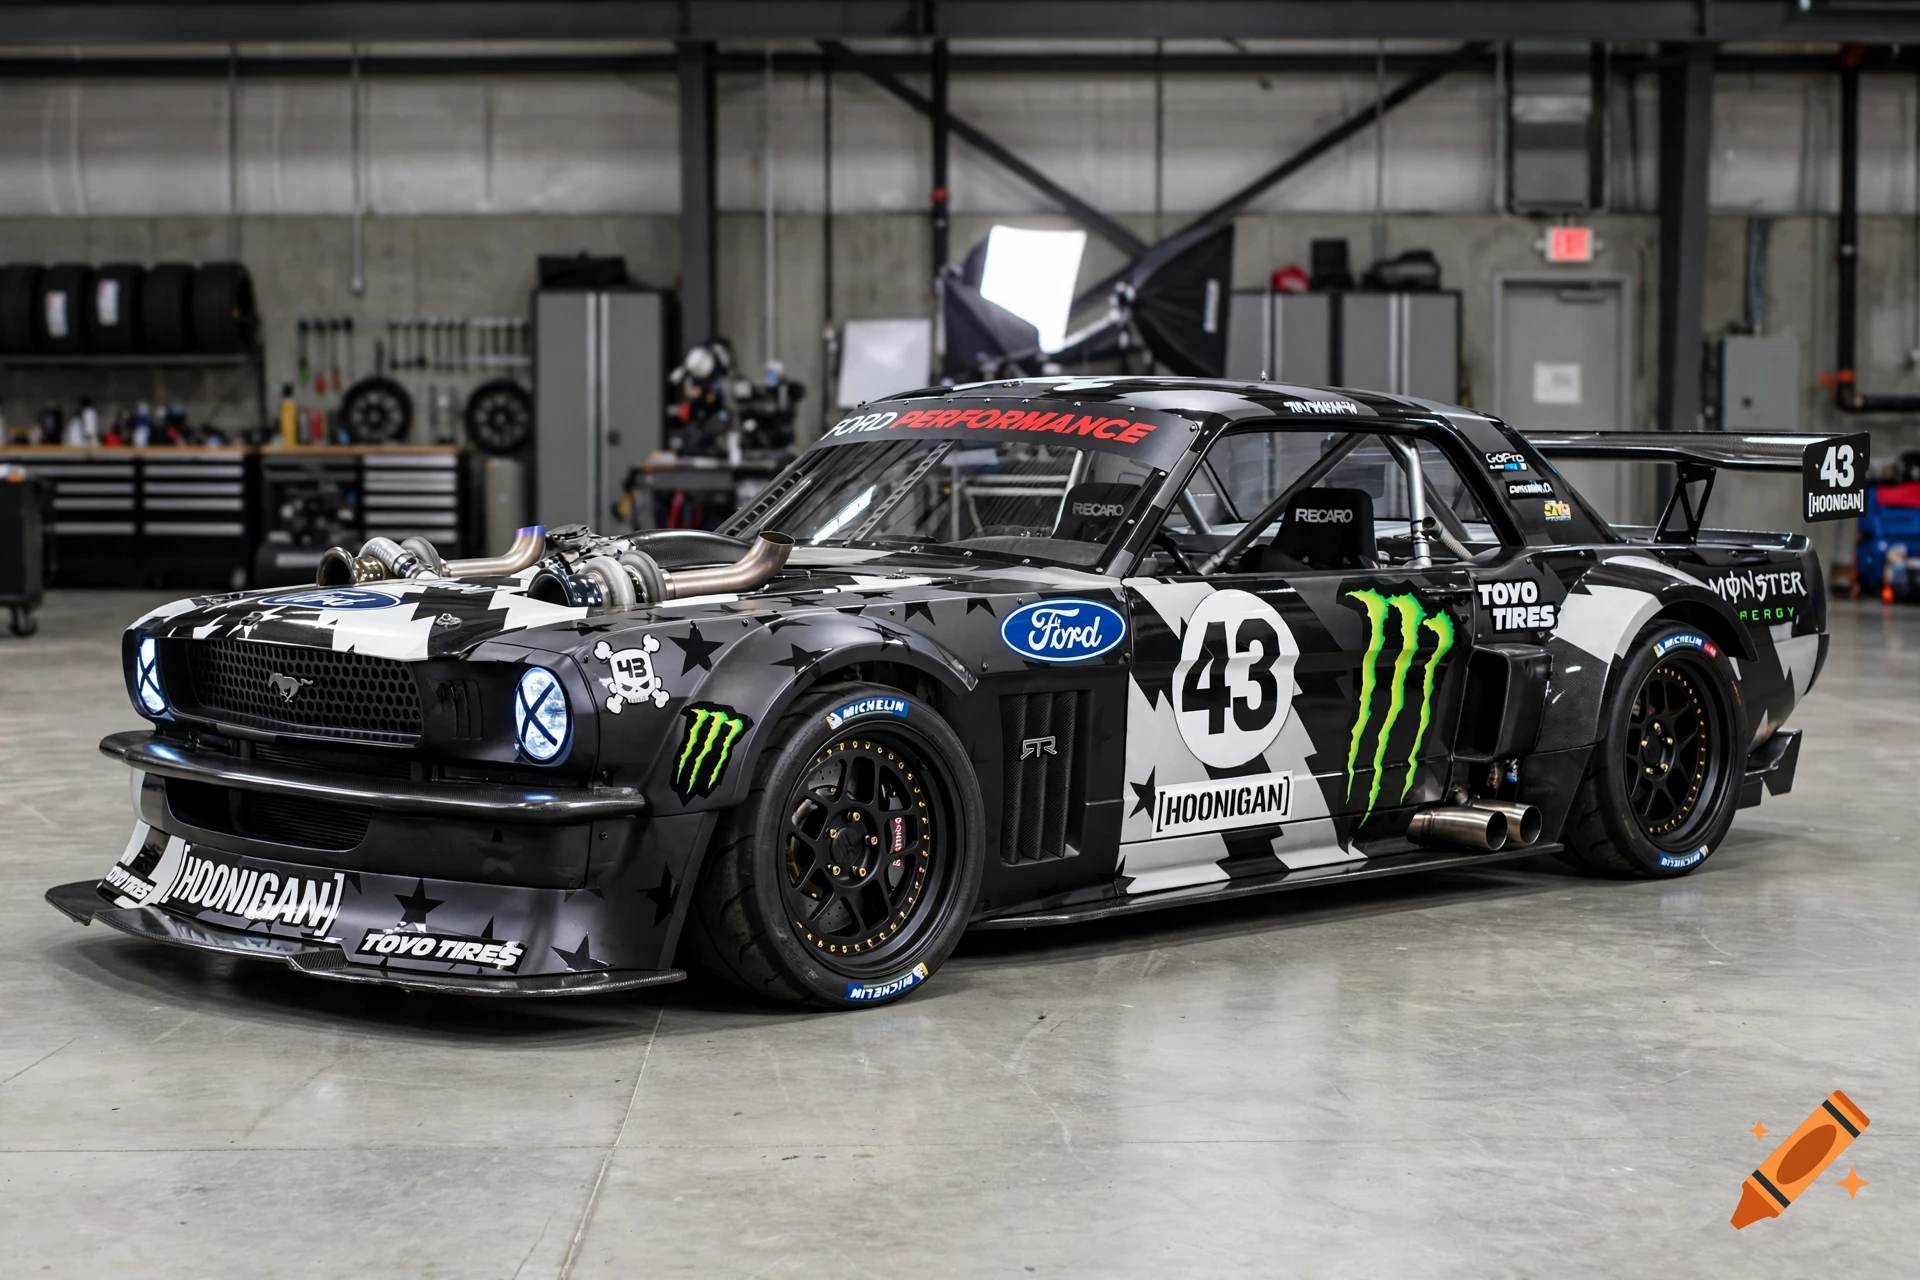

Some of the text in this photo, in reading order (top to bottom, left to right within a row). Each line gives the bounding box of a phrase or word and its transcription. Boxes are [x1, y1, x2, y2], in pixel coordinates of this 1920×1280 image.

[819, 408, 1157, 444] FORD PERFORMANCE
[1820, 444, 1855, 487] 43
[1072, 501, 1124, 517] RECARO
[1295, 508, 1353, 523] RECARO
[1477, 581, 1538, 606] TOYO
[1028, 608, 1103, 651] Ford
[1492, 604, 1555, 630] TIRES
[616, 657, 648, 678] 43
[1182, 618, 1281, 735] 43
[842, 699, 905, 719] MICHELIN
[361, 933, 523, 968] TOYO TIRES
[850, 974, 914, 999] MICHELIN
